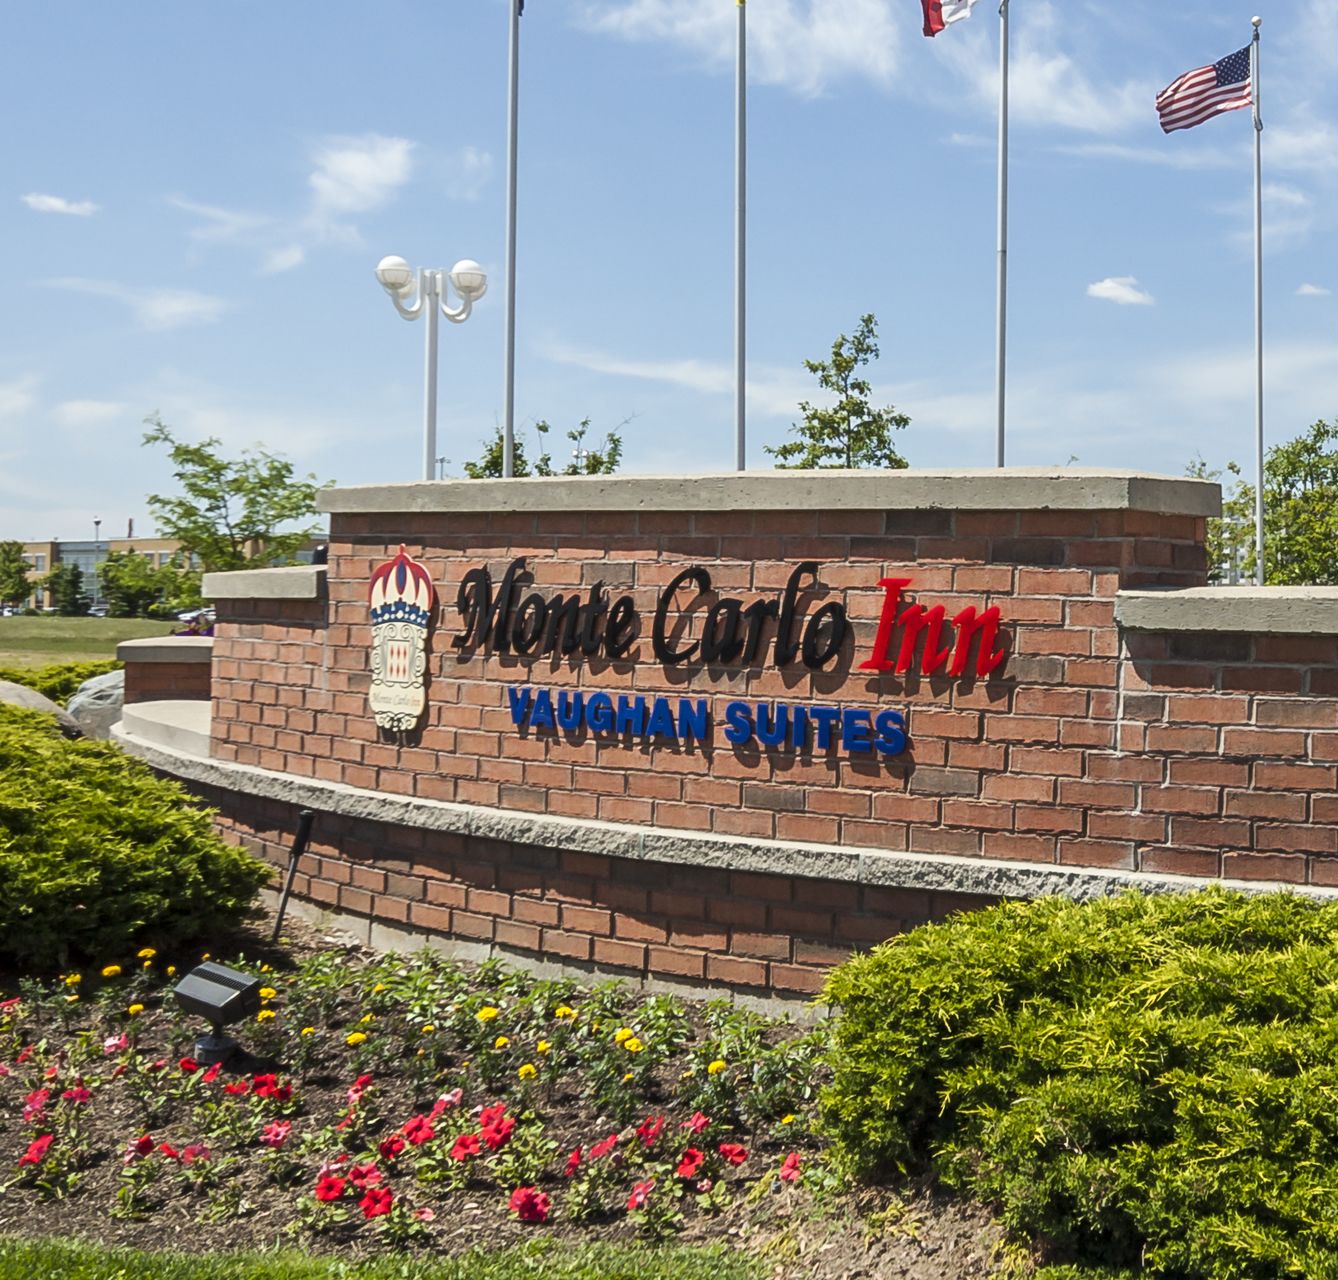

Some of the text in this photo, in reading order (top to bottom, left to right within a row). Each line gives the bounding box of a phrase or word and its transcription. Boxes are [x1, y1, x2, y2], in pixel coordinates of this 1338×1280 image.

[451, 556, 1004, 677] Monte Carlo Inn
[508, 686, 906, 756] VAUGHAN SUITES
